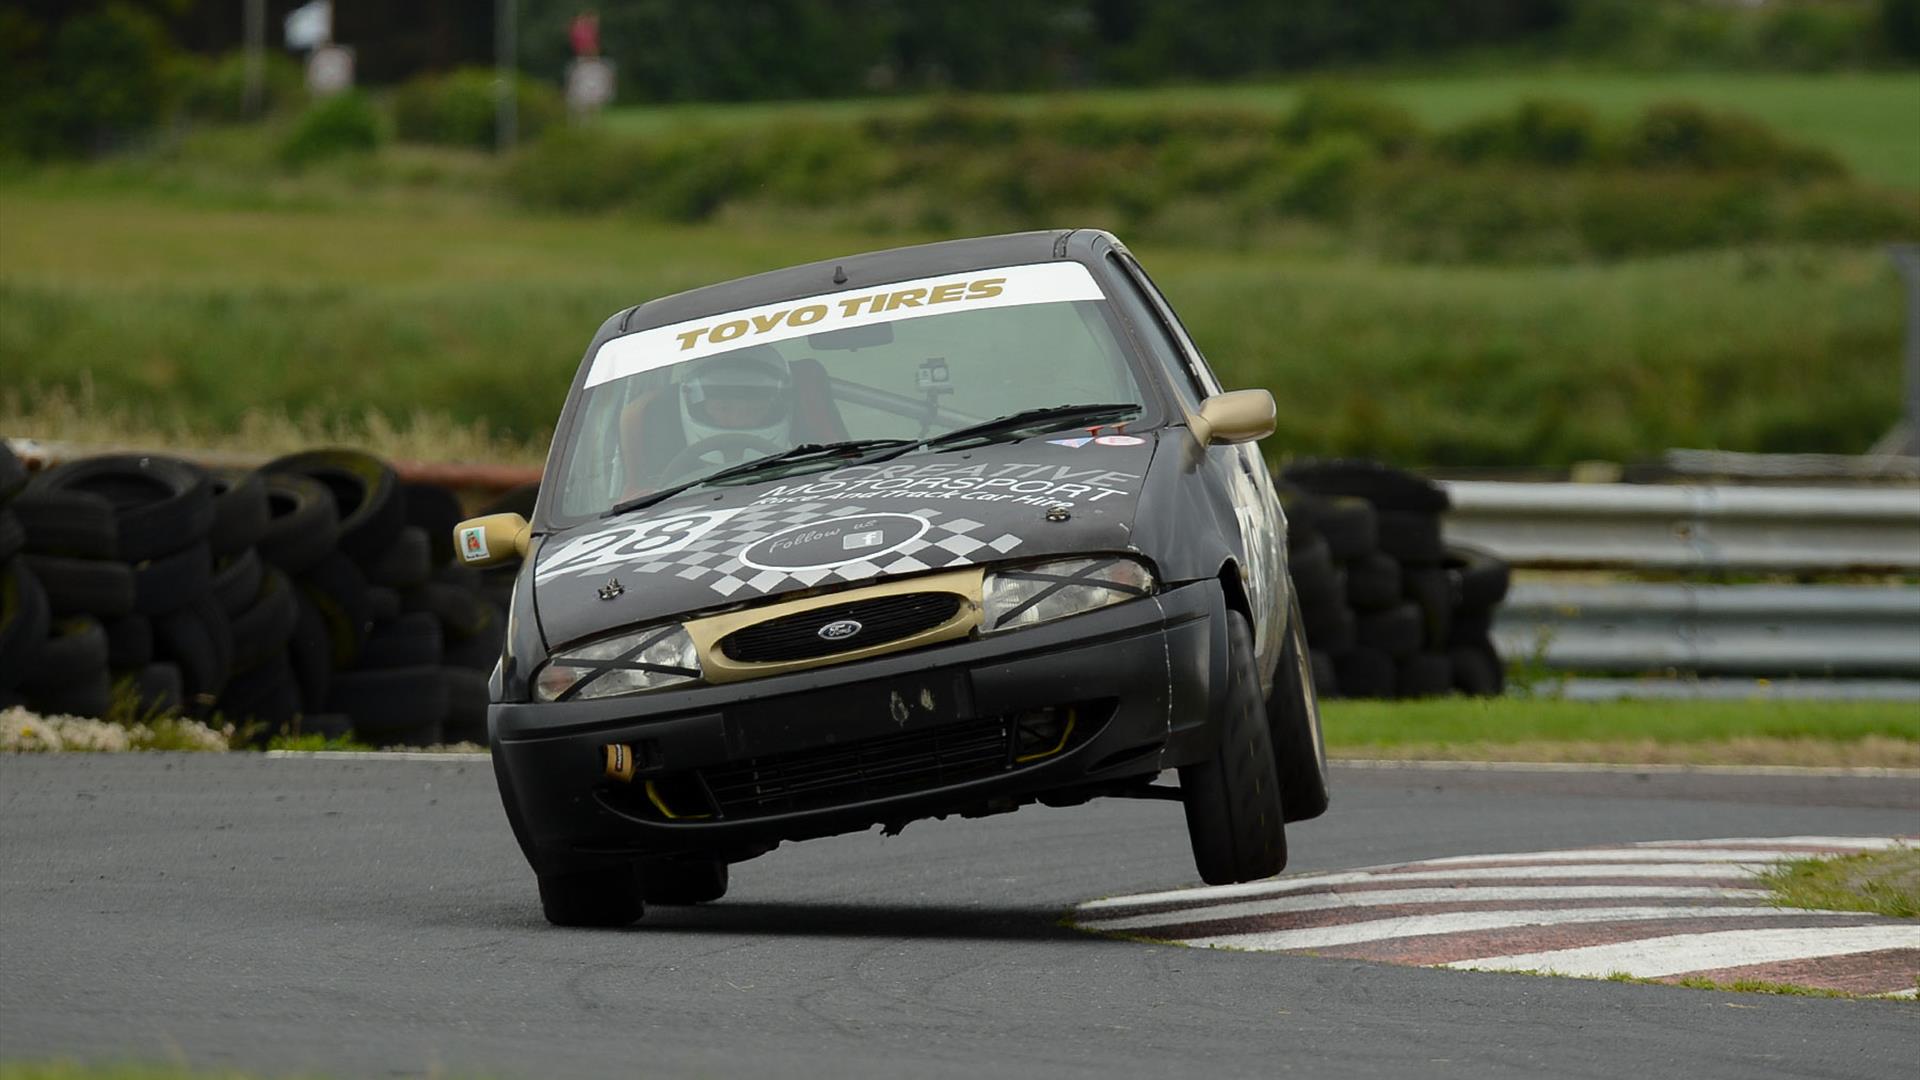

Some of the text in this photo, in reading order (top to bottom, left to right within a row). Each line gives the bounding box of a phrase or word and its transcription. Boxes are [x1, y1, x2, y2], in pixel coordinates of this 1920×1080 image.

[676, 278, 1007, 350] TOYO TIRES
[819, 463, 1141, 487] CREATIVE
[751, 489, 1075, 507] Race And Track Car Hire
[758, 478, 1129, 501] MOTORSPORT
[536, 516, 712, 576] 28
[769, 520, 877, 553] Follow us
